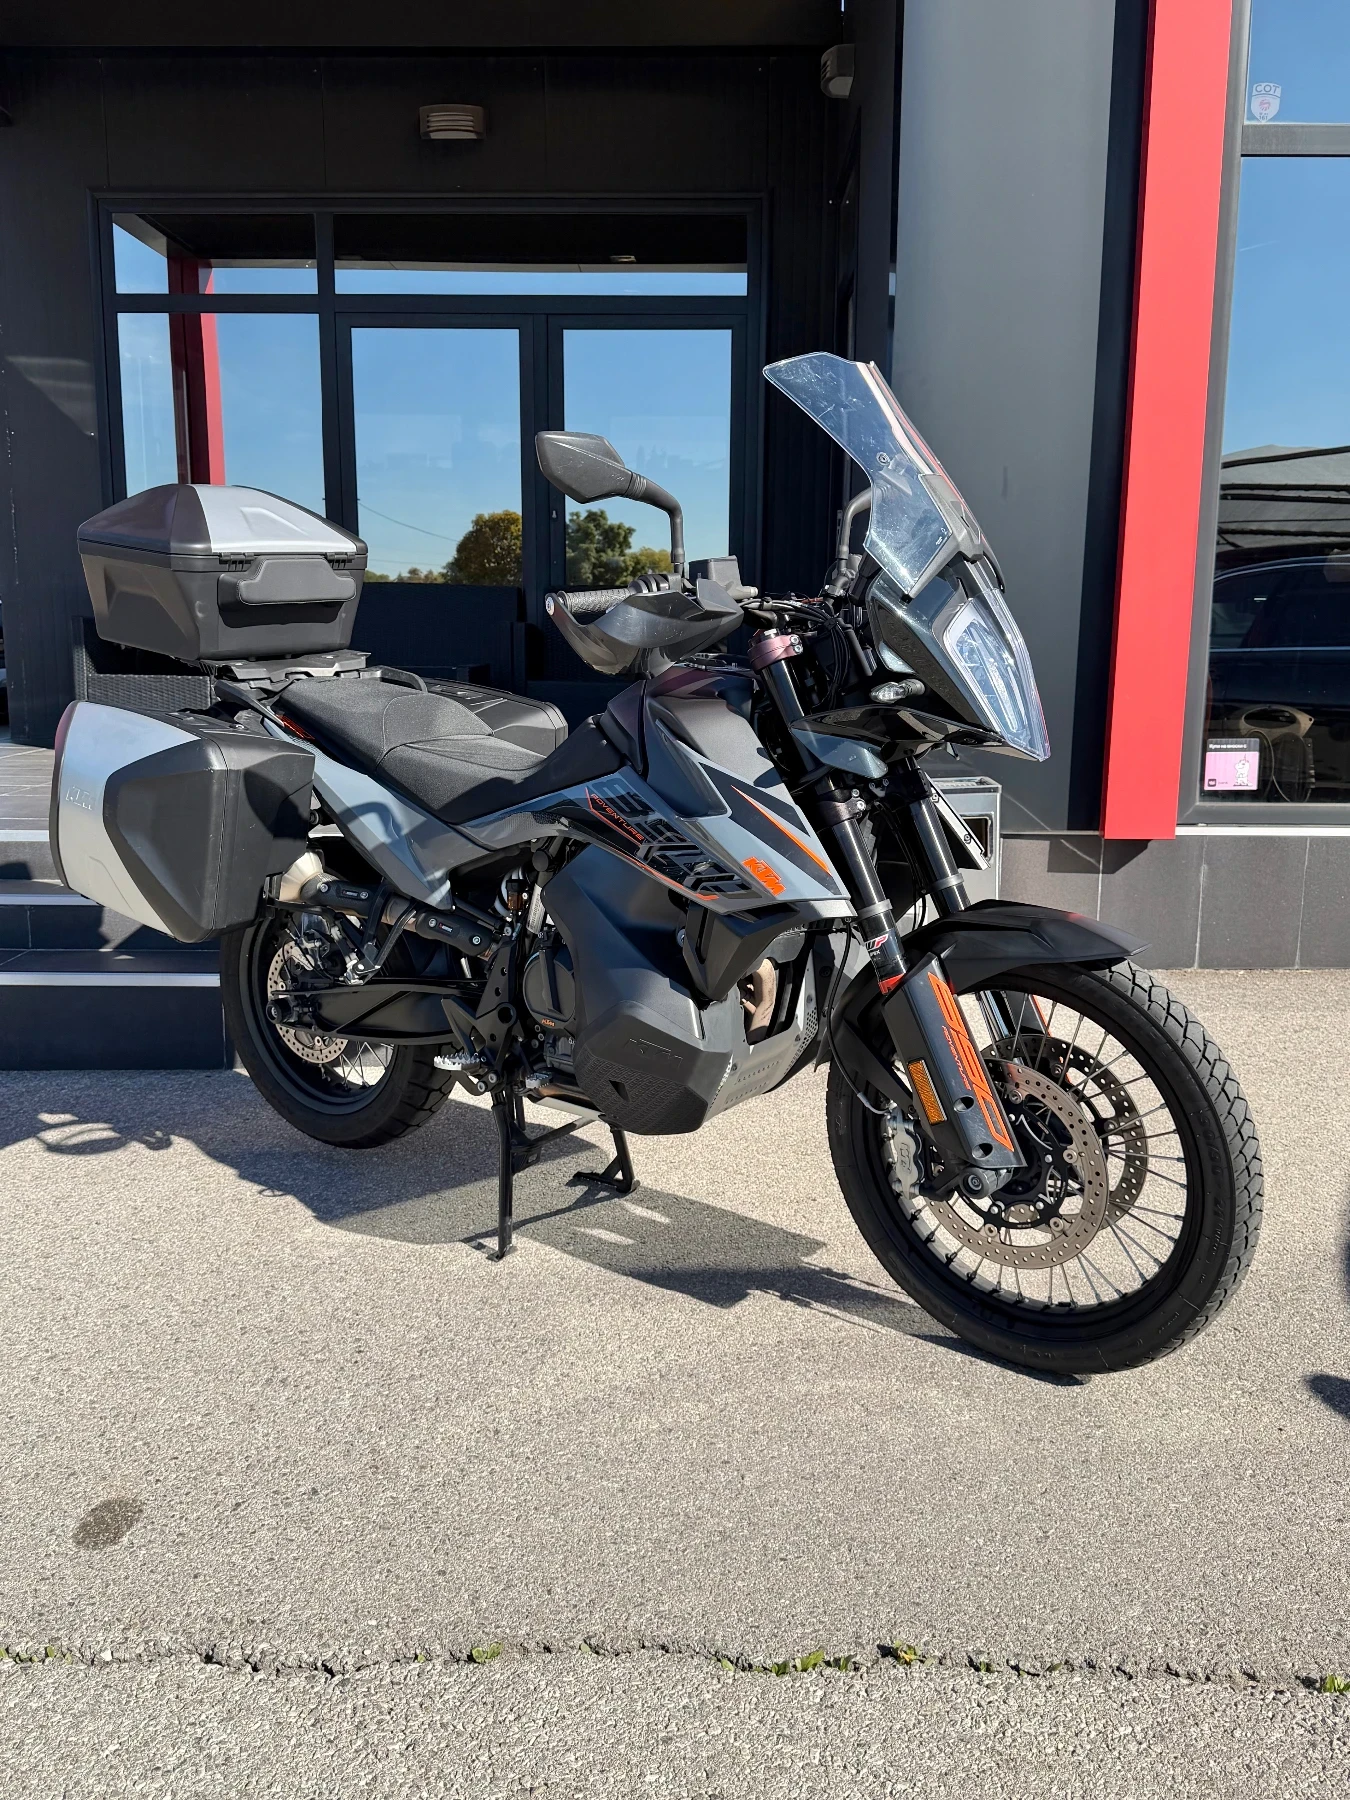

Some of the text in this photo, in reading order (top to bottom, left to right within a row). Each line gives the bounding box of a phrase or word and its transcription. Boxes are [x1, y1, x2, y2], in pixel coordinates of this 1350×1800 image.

[590, 793, 645, 841] ADVENTURE
[742, 856, 786, 896] KTM
[541, 1018, 556, 1028] KTM
[941, 1025, 972, 1091] ADVENTURE
